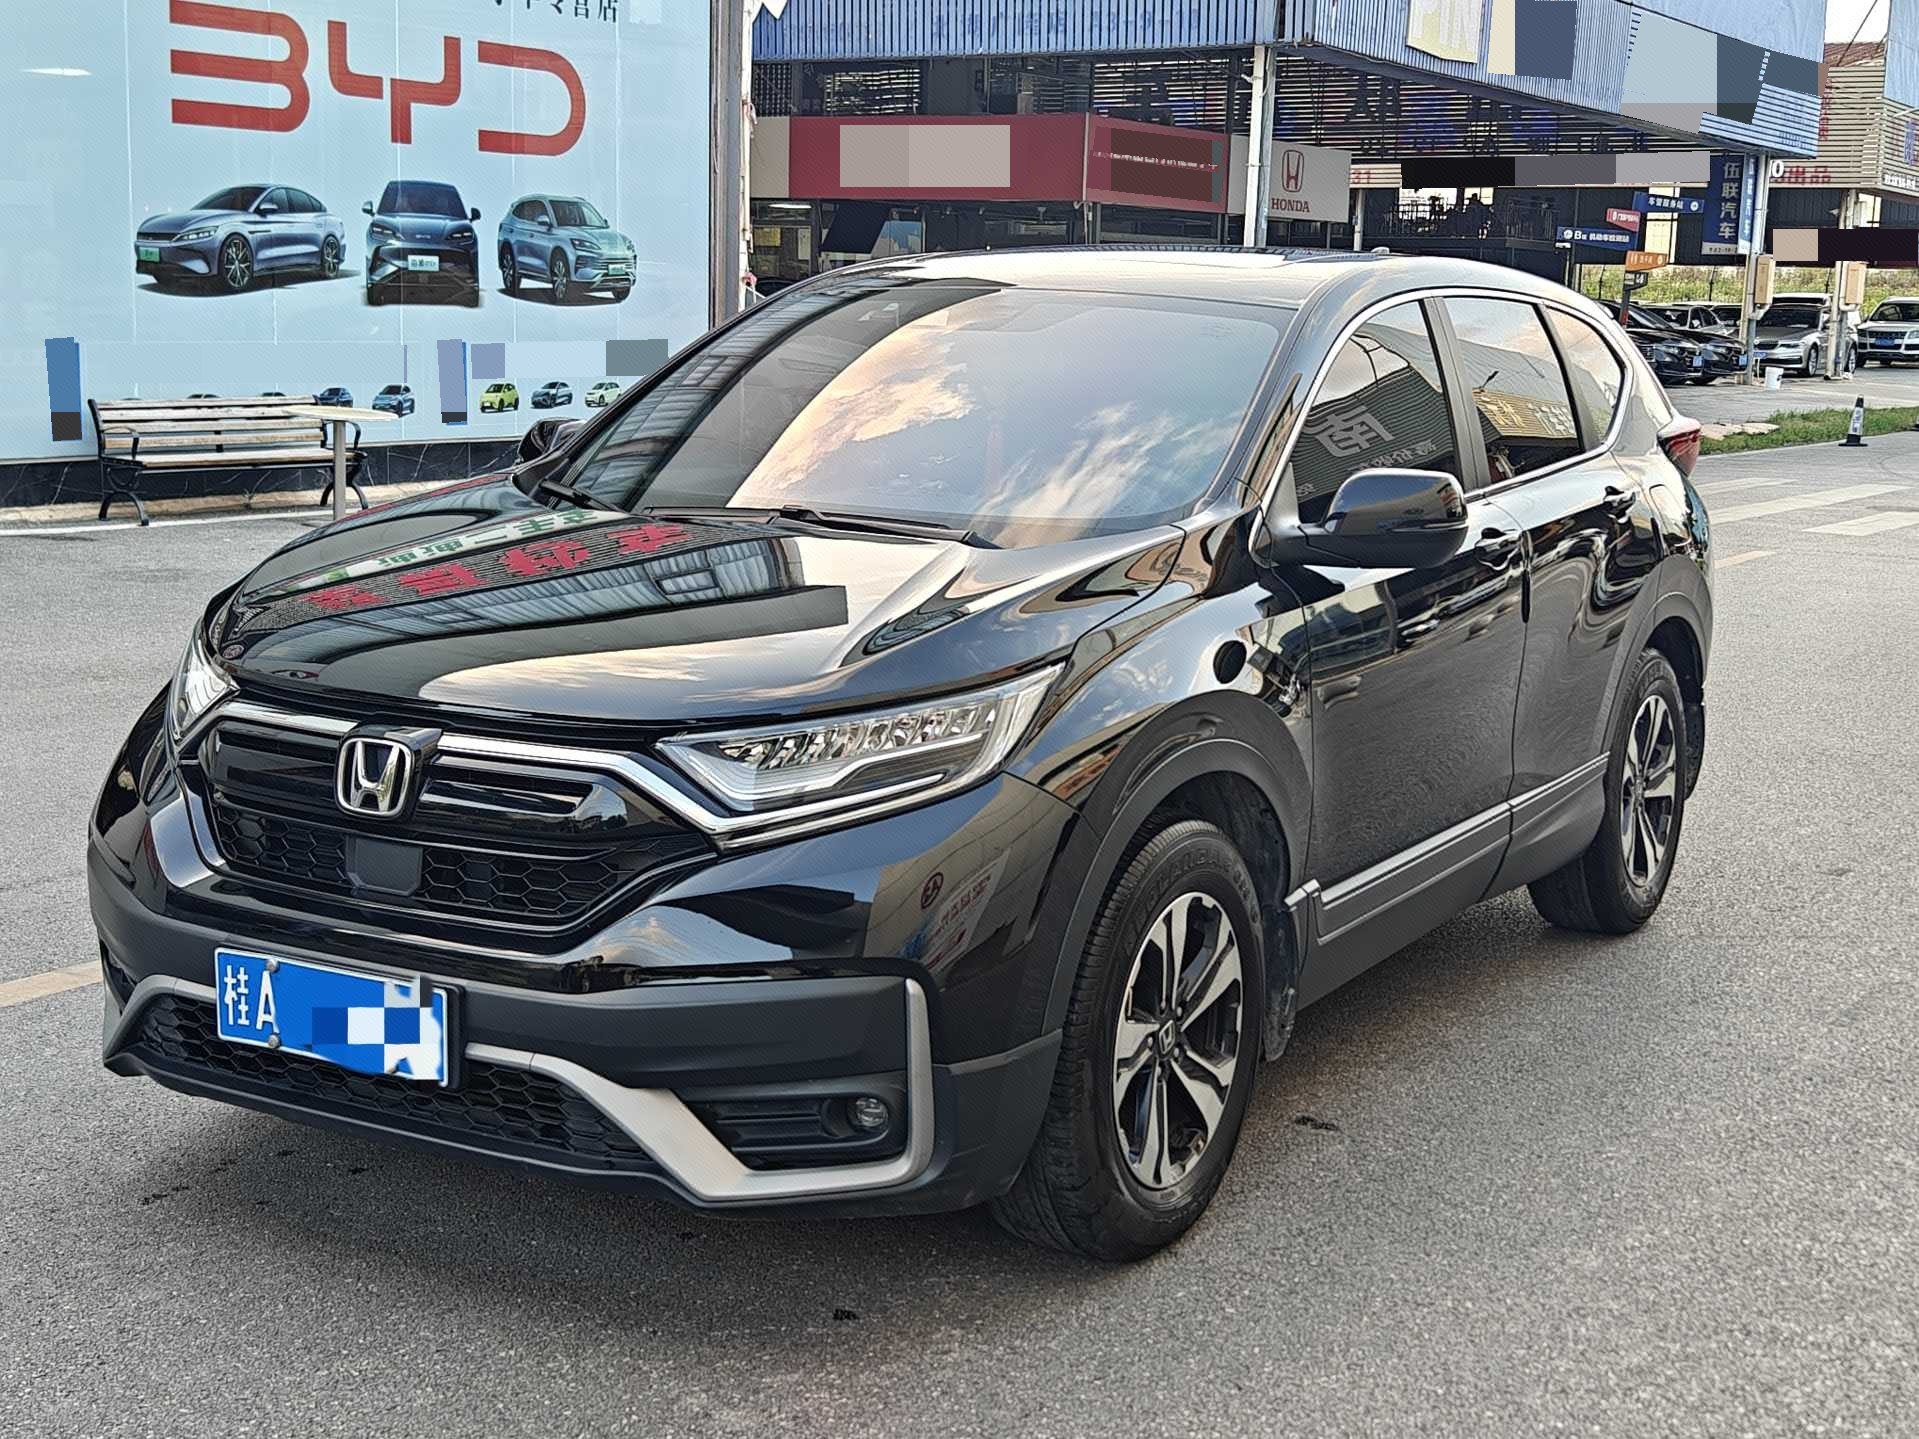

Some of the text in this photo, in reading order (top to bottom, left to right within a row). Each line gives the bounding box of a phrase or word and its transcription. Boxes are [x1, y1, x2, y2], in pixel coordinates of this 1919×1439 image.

[169, 0, 587, 157] BYD
[1271, 197, 1310, 213] HONDA
[1717, 161, 1740, 240] 伍联汽车
